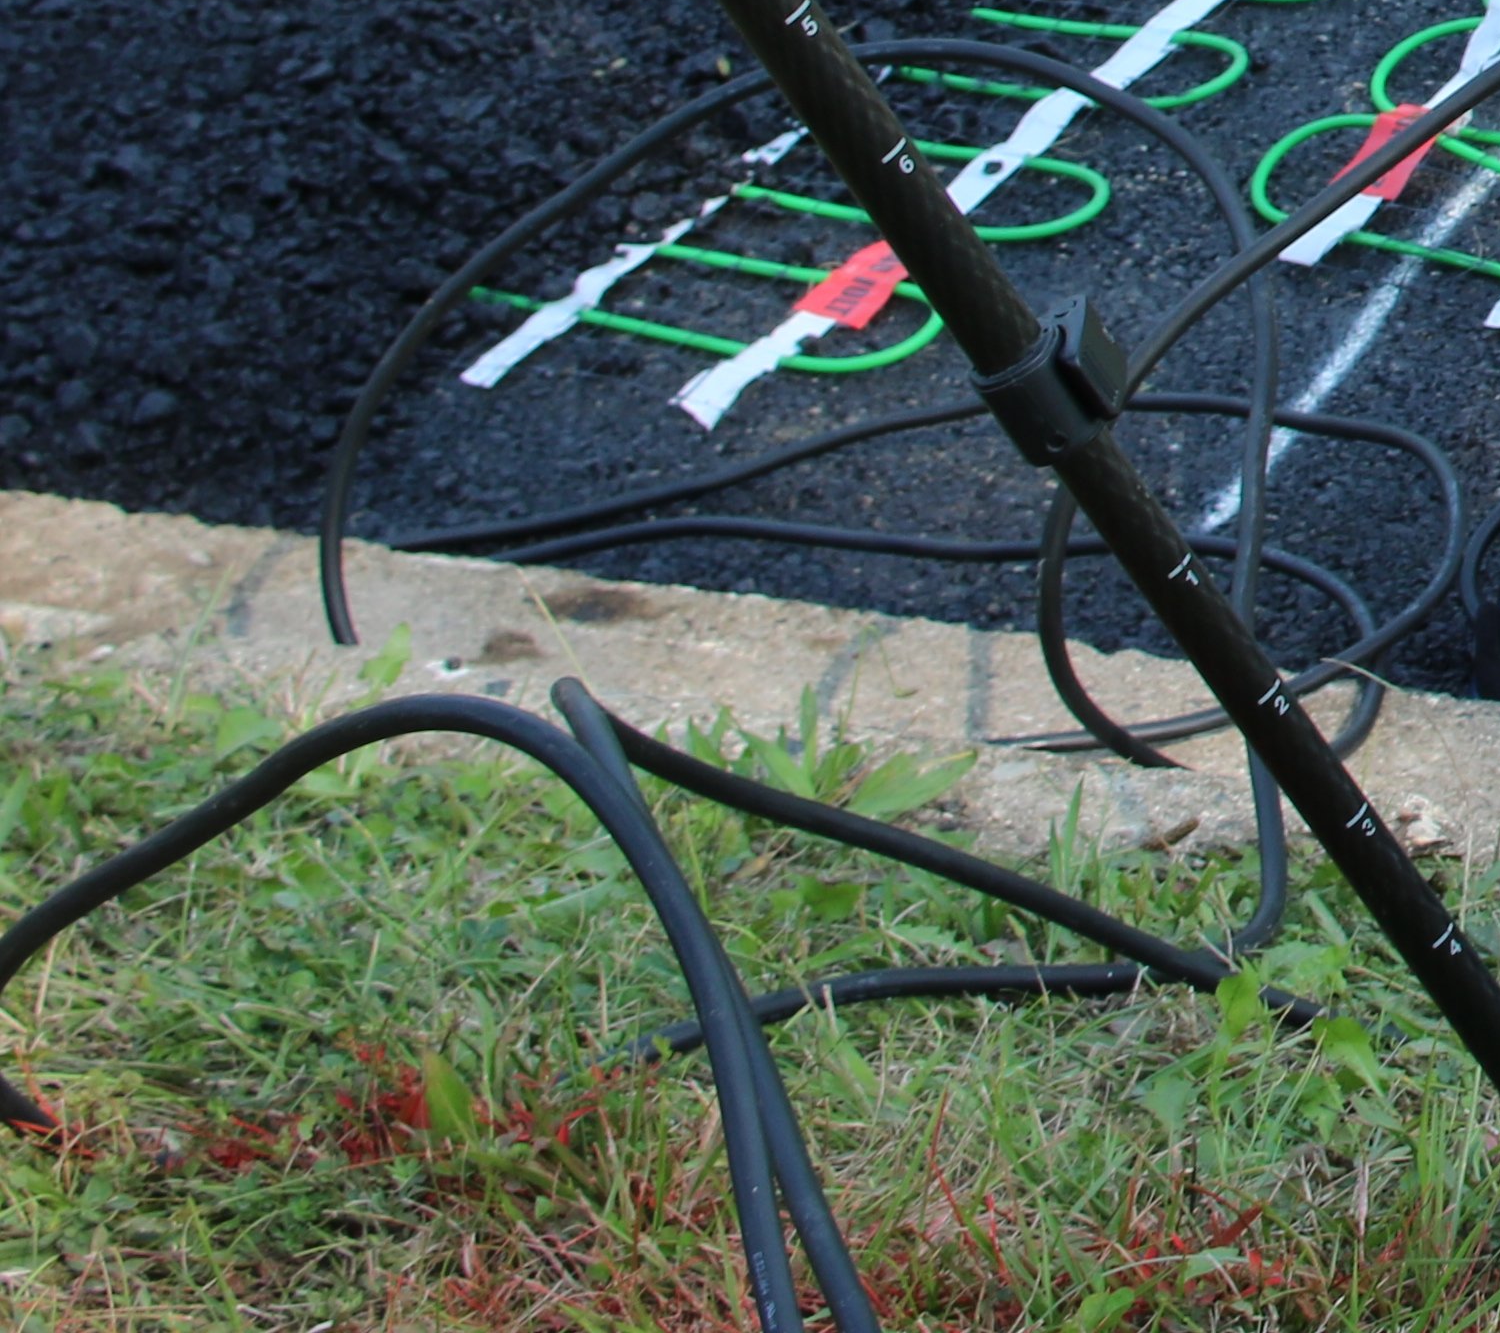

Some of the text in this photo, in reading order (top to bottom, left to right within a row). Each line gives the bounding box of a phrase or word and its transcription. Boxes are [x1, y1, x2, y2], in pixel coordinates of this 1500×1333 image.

[800, 13, 819, 38] 5
[898, 152, 916, 175] 6
[1273, 694, 1290, 717] 2
[1361, 817, 1377, 838] 3
[1449, 938, 1463, 957] 4
